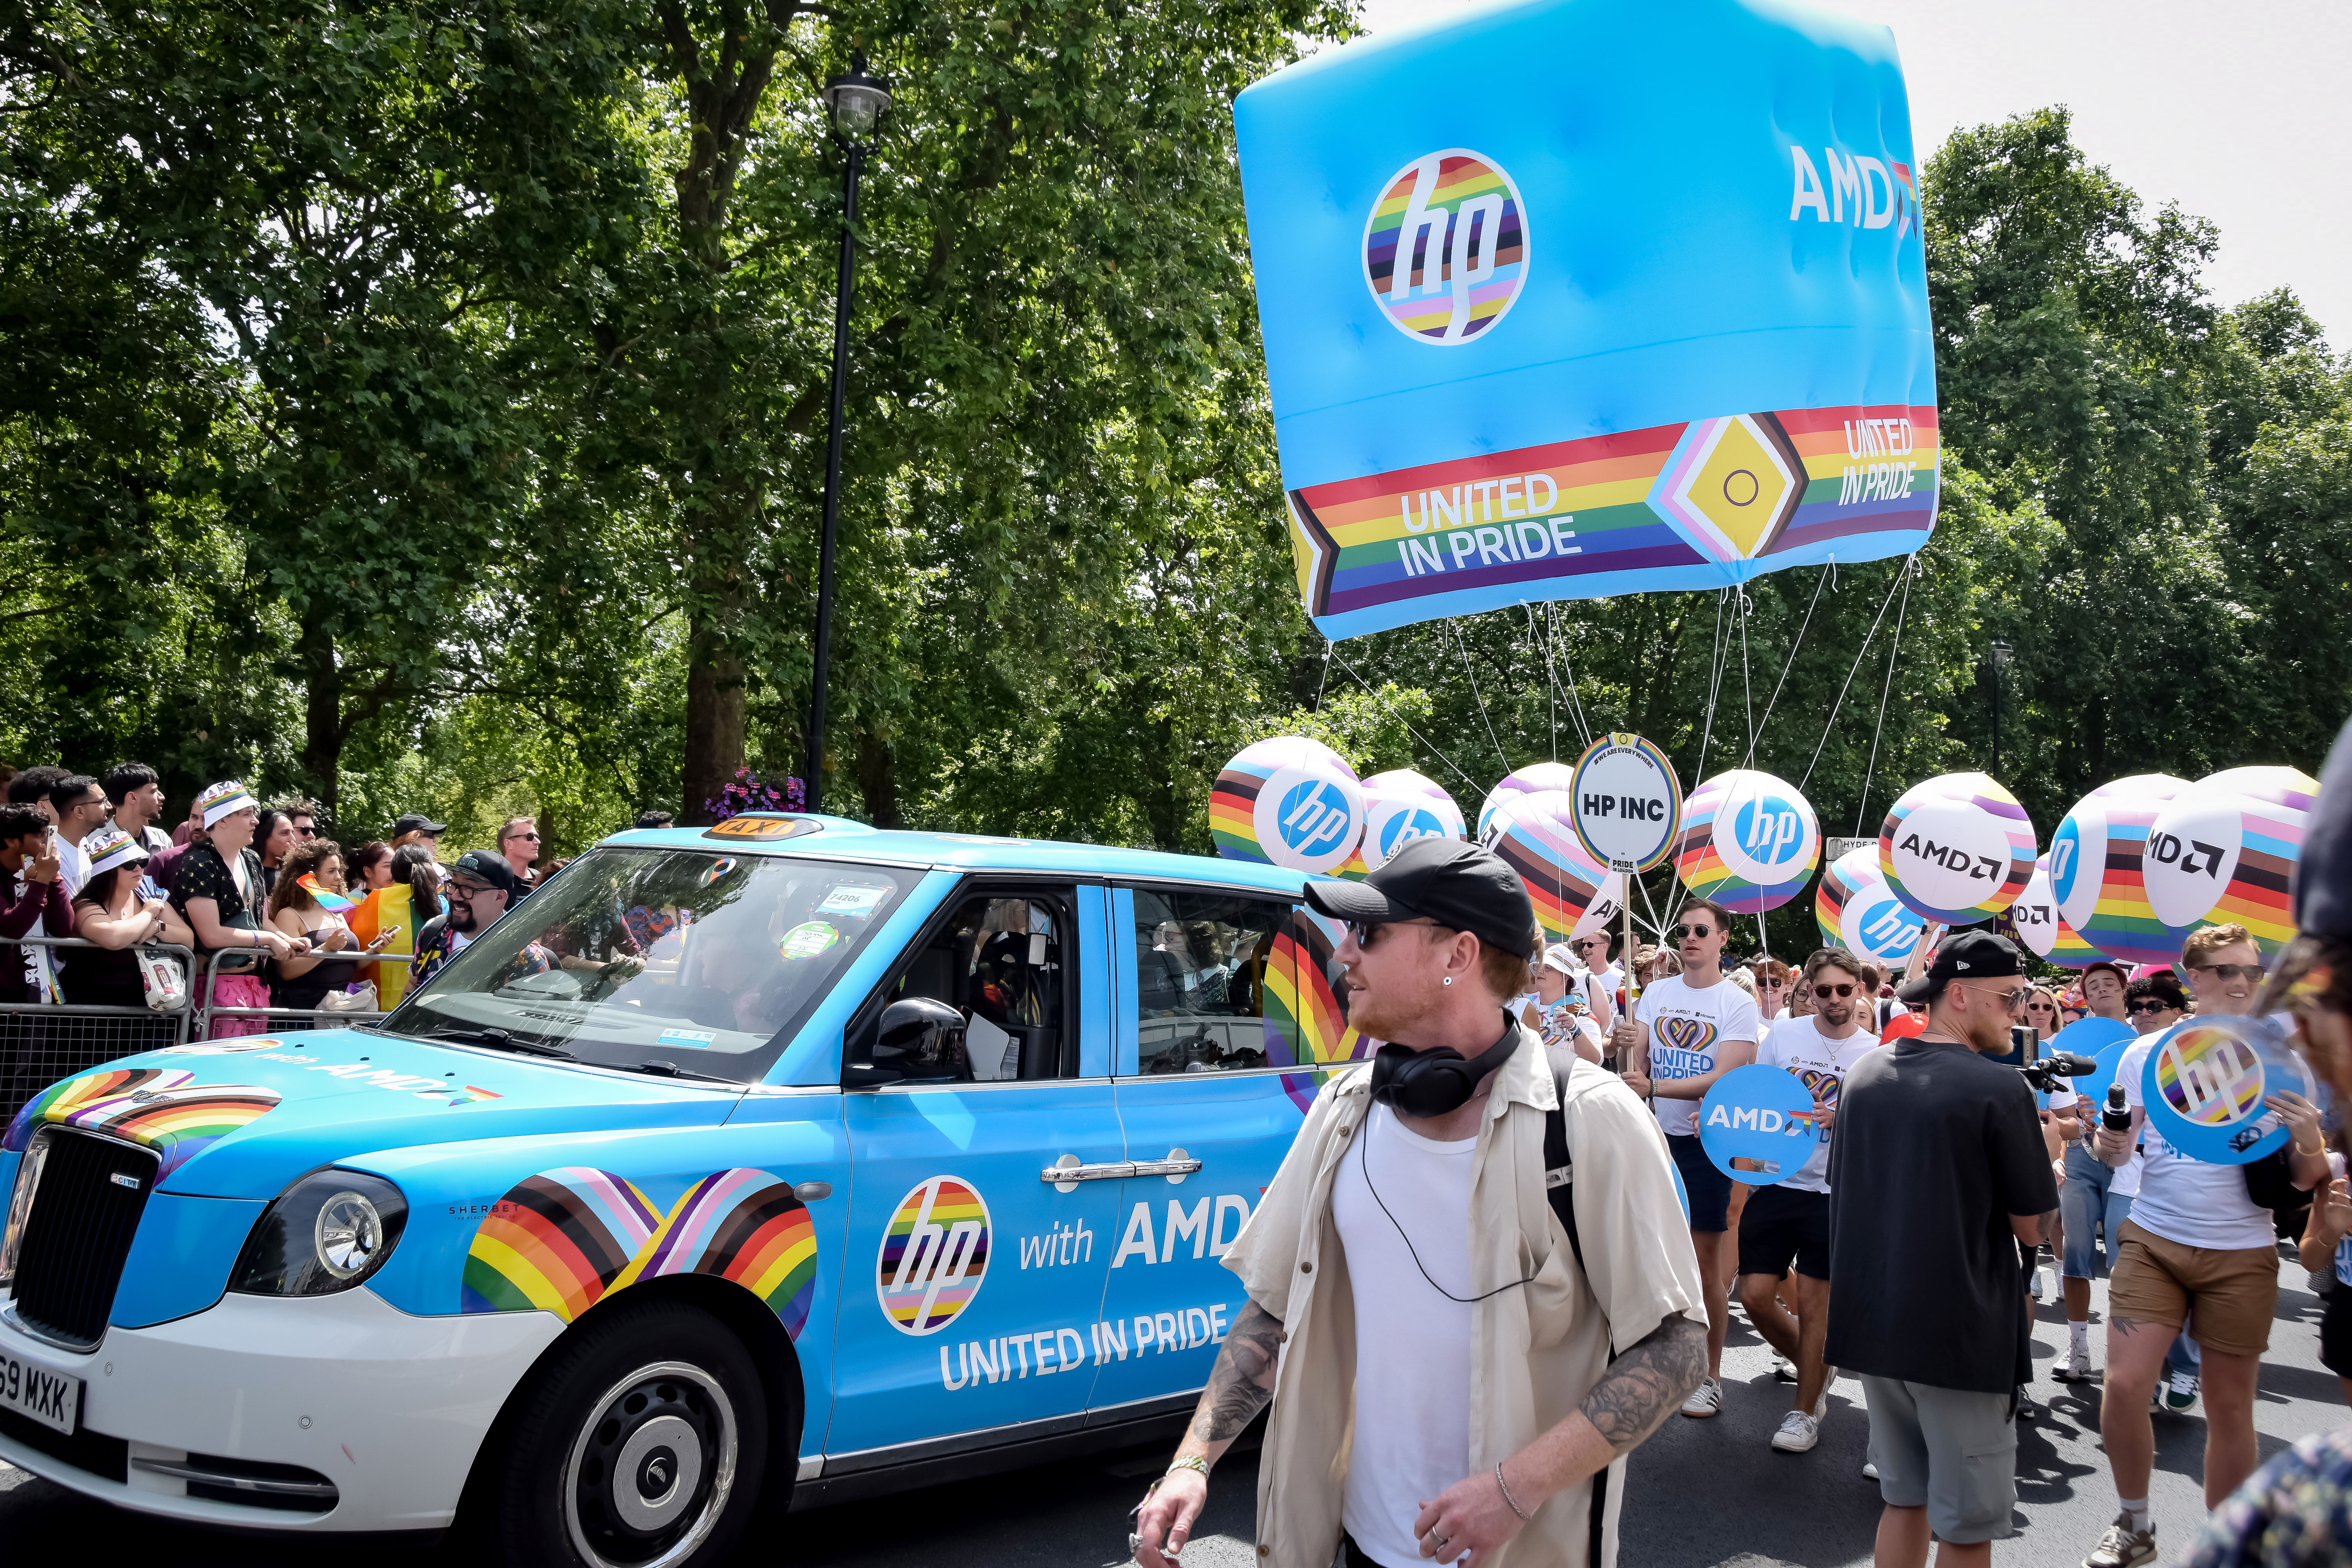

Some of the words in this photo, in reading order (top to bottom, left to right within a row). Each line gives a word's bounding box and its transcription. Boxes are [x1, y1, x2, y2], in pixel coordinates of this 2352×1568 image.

[1790, 145, 1895, 230] AMD
[1391, 150, 1504, 344] hp
[1844, 417, 1913, 457] UNITED
[1400, 472, 1559, 535] UNITED
[1838, 465, 1862, 507] IN
[1862, 461, 1916, 502] PRIDE
[1397, 534, 1448, 577] IN
[1454, 515, 1583, 570] PRIDE
[718, 820, 788, 834] TAXI
[1283, 780, 1348, 854] hp
[1584, 793, 1616, 817] HP
[1621, 796, 1664, 822] INC
[1746, 797, 1797, 864] hp
[1612, 859, 1633, 869] PRIDE
[1899, 833, 1971, 872] AMD
[2144, 829, 2181, 864] MD
[829, 894, 861, 902] 74206
[2012, 904, 2028, 922] MD
[1863, 900, 1922, 956] hp
[303, 1064, 448, 1091] AMD
[1653, 1048, 1713, 1072] UNITED
[2166, 1040, 2246, 1122] hp
[1706, 1104, 1783, 1132] AMD
[449, 1204, 520, 1215] SHERBET
[1020, 1218, 1093, 1270] with
[1111, 1194, 1250, 1268] AMD
[889, 1175, 982, 1330] hp
[940, 1328, 1085, 1391] UNITED
[1091, 1319, 1129, 1366] IN
[1135, 1303, 1227, 1357] PRIDE
[24, 1366, 68, 1422] MXK
